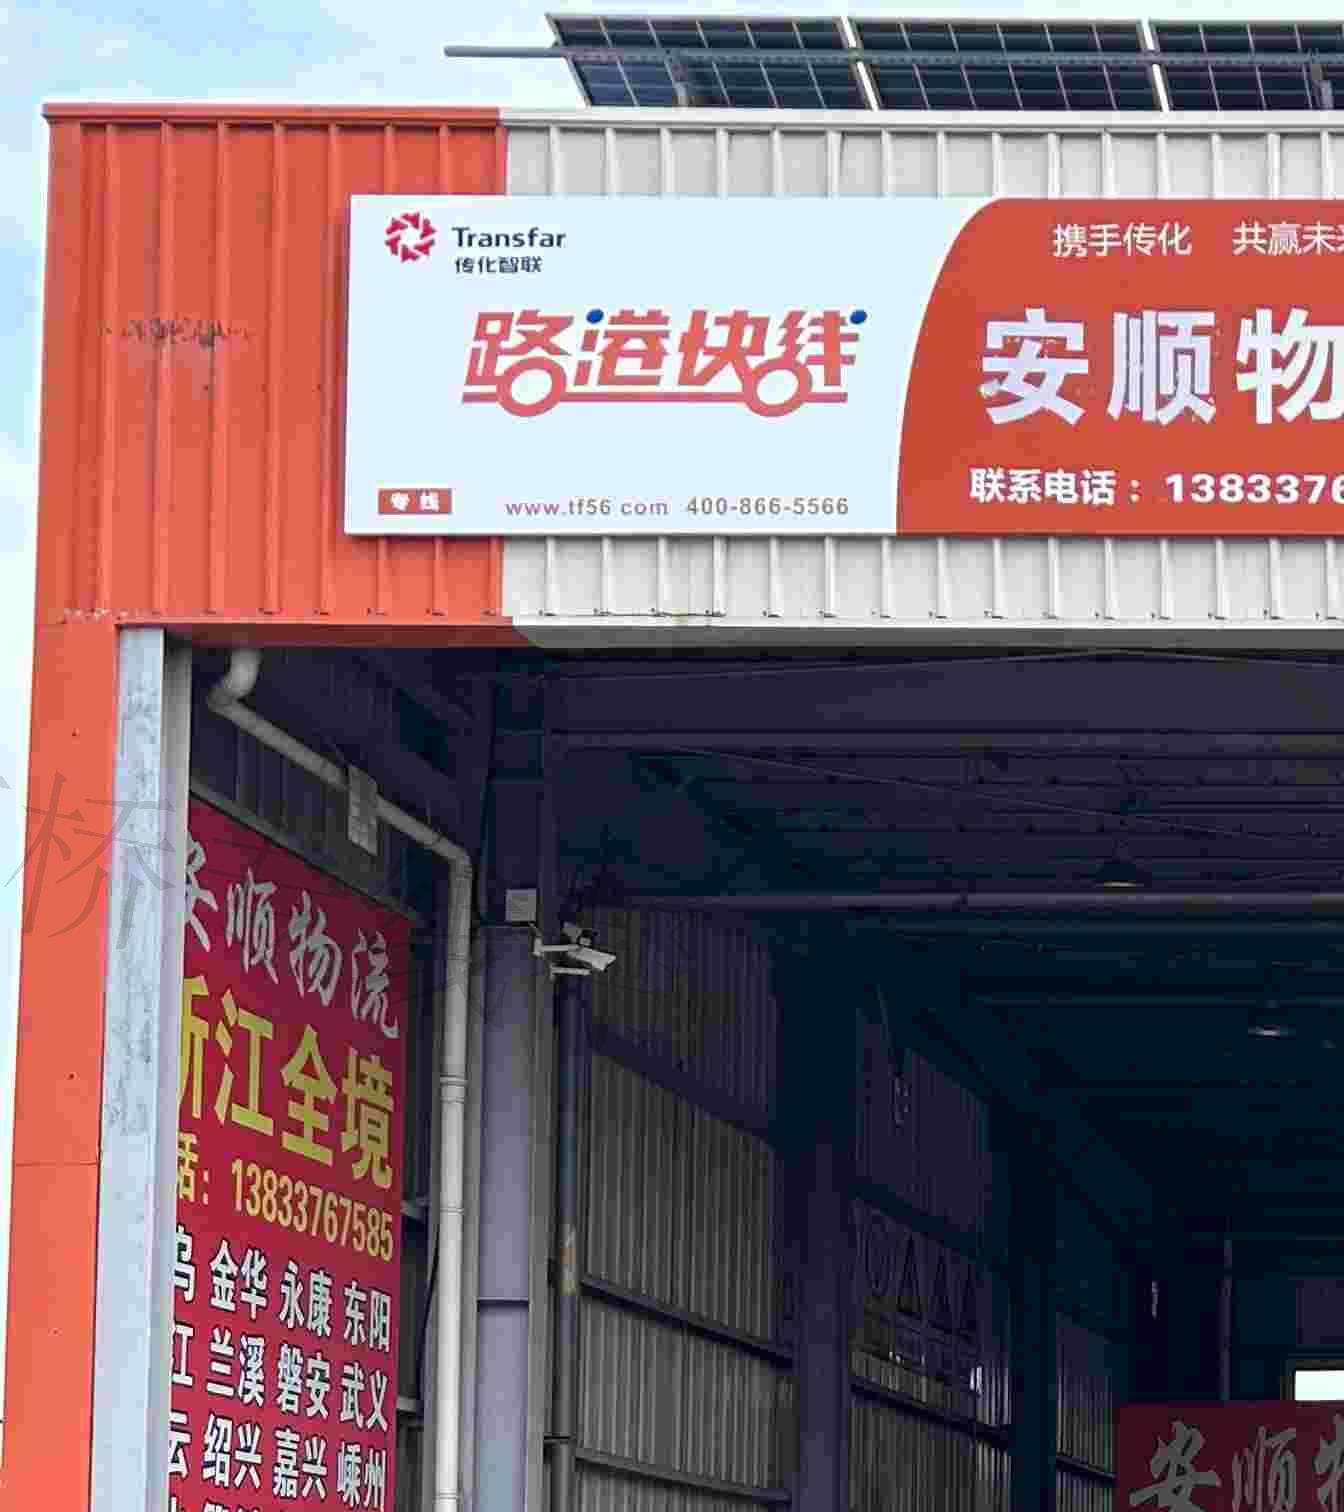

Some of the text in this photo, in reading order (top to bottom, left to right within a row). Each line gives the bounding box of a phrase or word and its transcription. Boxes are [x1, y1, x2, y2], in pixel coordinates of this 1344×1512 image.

[451, 226, 566, 248] Transfar
[454, 256, 543, 274] 传化智联
[1052, 222, 1192, 258] 携手传化
[461, 307, 867, 417] 路港快线
[504, 496, 849, 516] www.tf56.com 400-866-5566
[231, 1159, 394, 1261] 13833767585
[209, 1239, 267, 1320] 金华
[279, 1259, 332, 1338] 永康
[343, 1280, 391, 1353] 东阳
[206, 1328, 265, 1407] 兰溪
[277, 1344, 330, 1419] 磐安
[340, 1362, 389, 1432] 武义
[202, 1414, 263, 1489] 绍兴
[273, 1427, 328, 1500] 嘉兴
[336, 1442, 386, 1512] 嵊州
